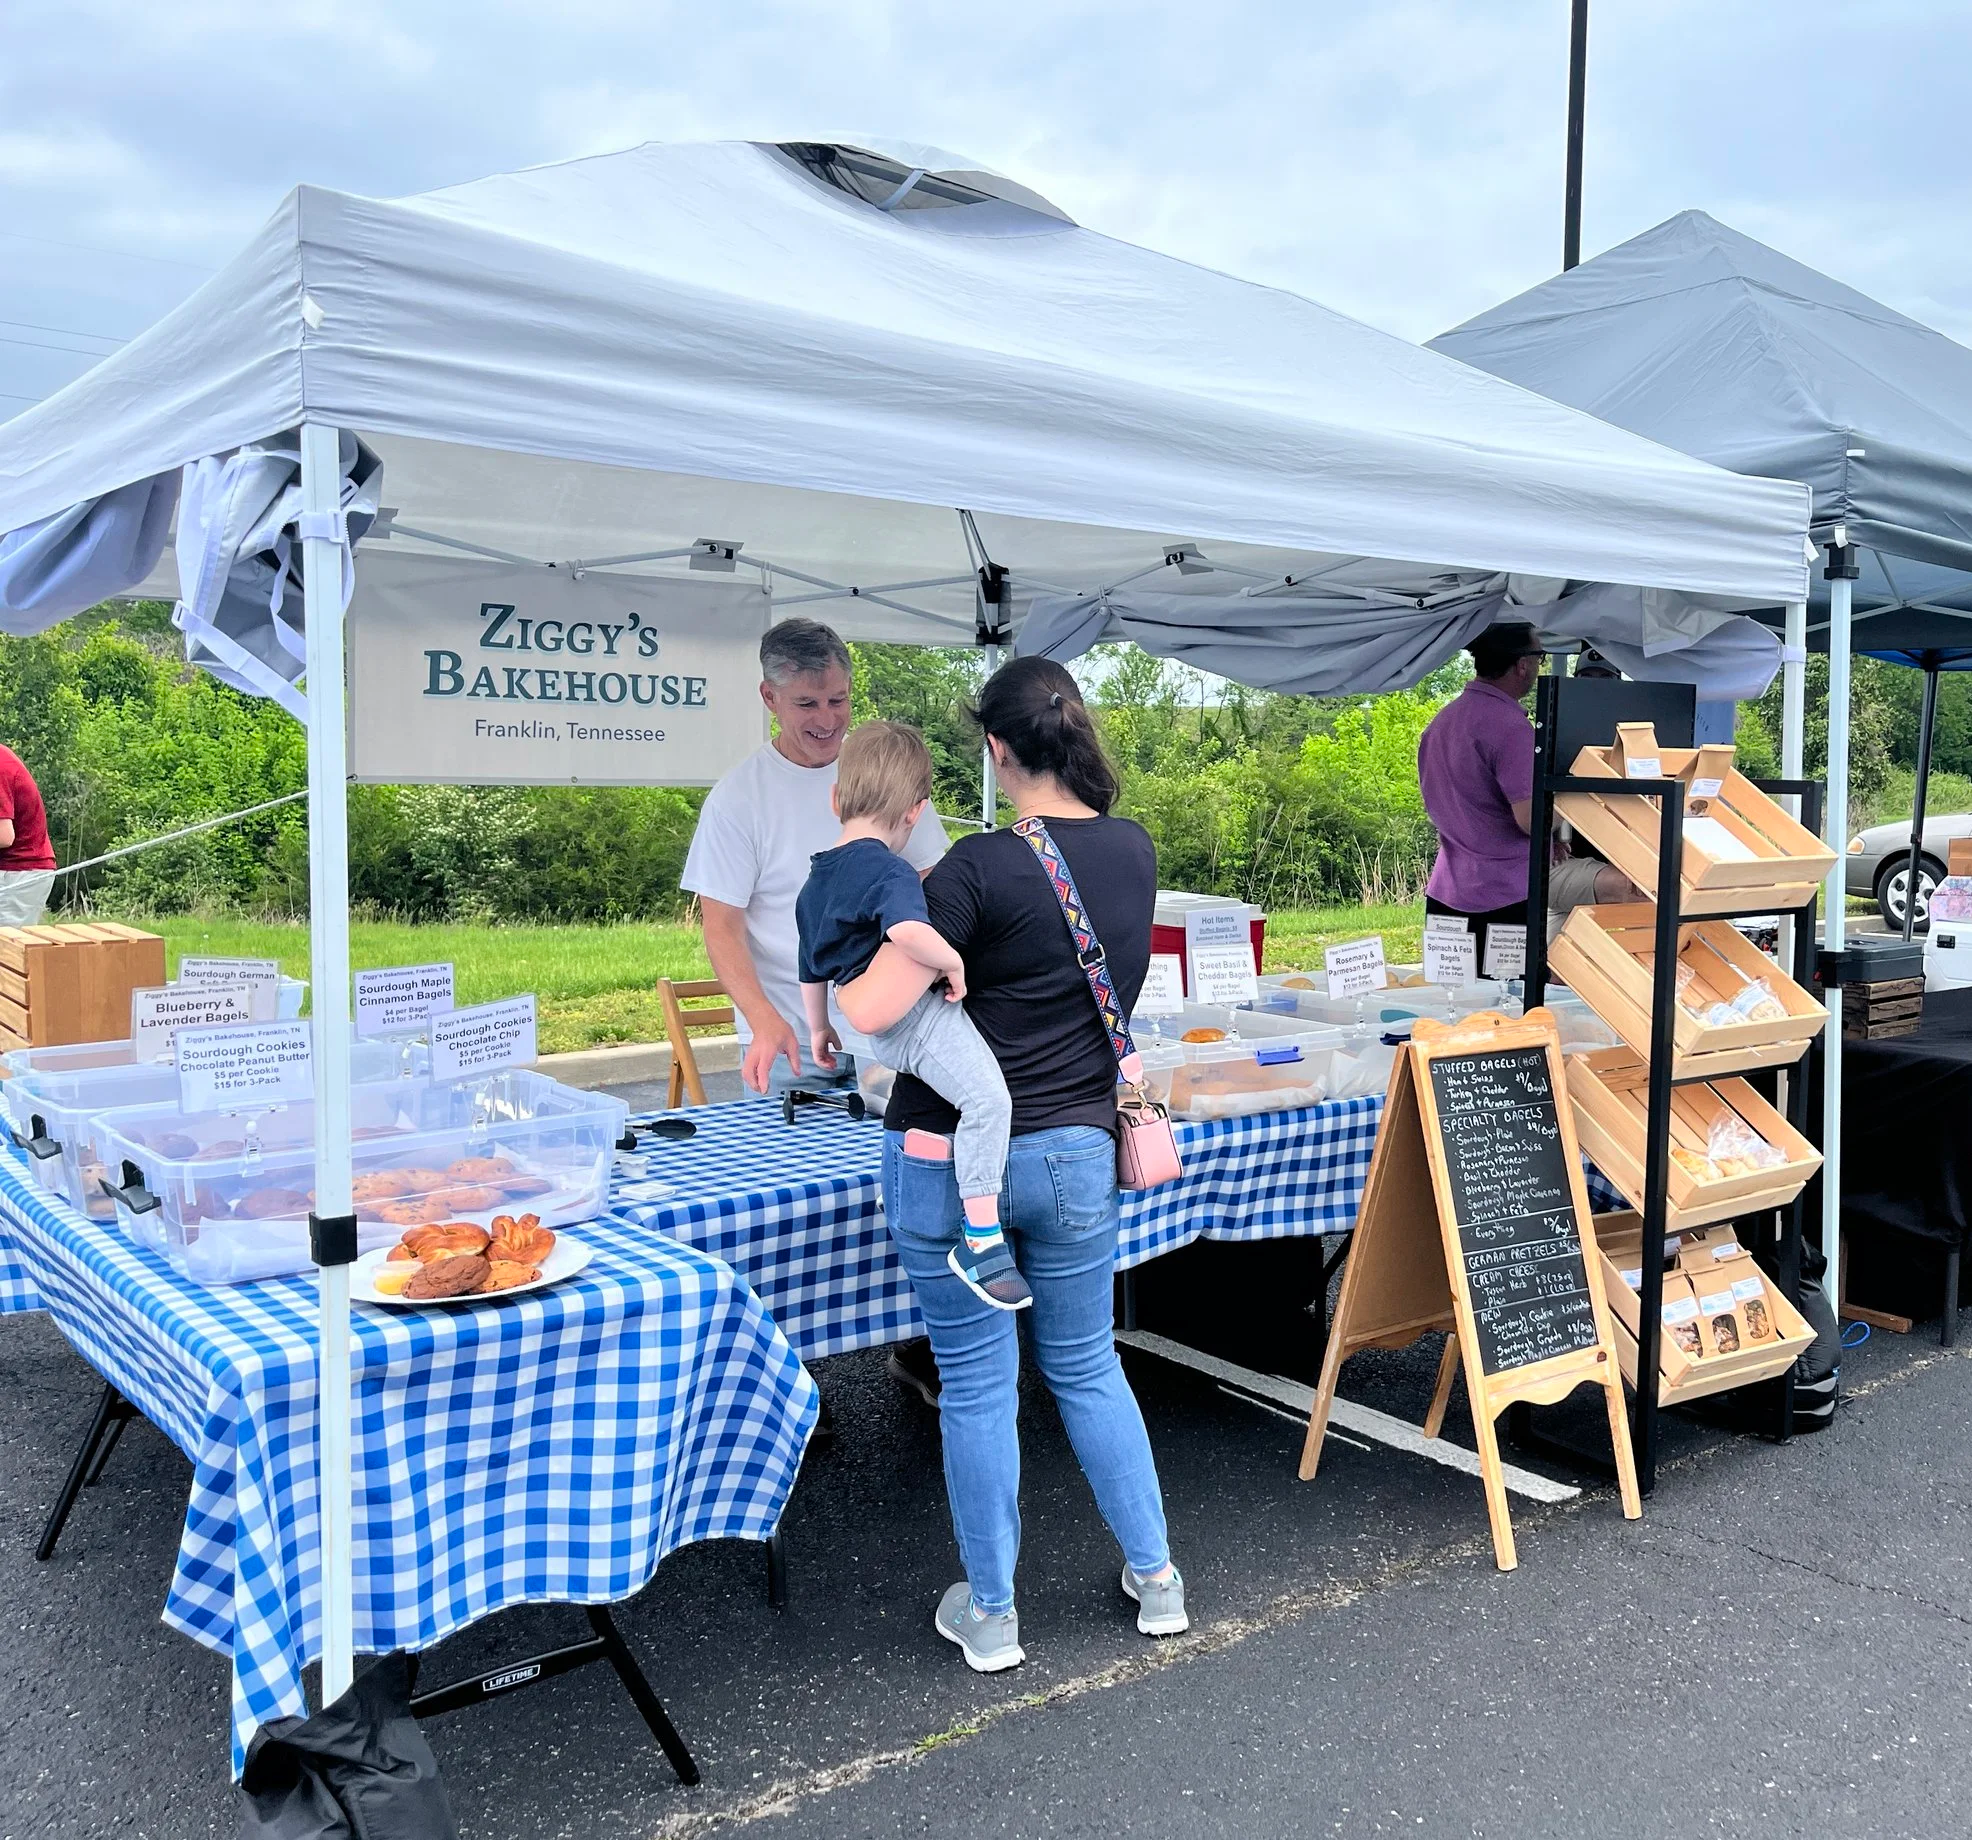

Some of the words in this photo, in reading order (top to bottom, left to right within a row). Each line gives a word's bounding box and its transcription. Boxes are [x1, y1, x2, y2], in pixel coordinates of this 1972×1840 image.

[422, 649, 708, 707] BAKEHOUSE
[475, 719, 561, 742] Franklin,
[566, 721, 666, 743] Tennessee
[1201, 916, 1214, 925] Hot
[1215, 915, 1235, 924] Items
[1427, 943, 1452, 952] Spinach
[1453, 945, 1458, 953] &
[1459, 945, 1473, 954] Feta
[1199, 961, 1221, 970] Sweet
[1222, 960, 1241, 969] Basil
[1242, 960, 1248, 968] &
[1336, 953, 1368, 966] Rosemary
[1440, 953, 1460, 963] Bagels
[183, 969, 237, 980] Sourdough
[239, 971, 275, 980] German
[1150, 962, 1168, 972] thing
[1198, 971, 1227, 981] Cheddar
[1229, 970, 1252, 980] Bagels
[1328, 965, 1361, 977] Parmesan
[1362, 959, 1384, 970] Bagels
[359, 980, 418, 994] Sourdough
[421, 976, 451, 988] Maple
[1146, 973, 1162, 982] gels
[144, 991, 168, 999] Ziggy's
[359, 994, 414, 1007] Cinnamon
[417, 988, 452, 1001] Bagels
[156, 1000, 221, 1013] Blueberry
[225, 998, 235, 1008] &
[385, 1008, 394, 1016] $4
[395, 1008, 407, 1016] per
[408, 1004, 429, 1013] Bagel
[140, 1014, 202, 1028] Lavender
[205, 1010, 249, 1023] Bagels
[382, 1016, 395, 1024] $12
[408, 1012, 430, 1021] 3-Pac
[185, 1034, 212, 1044] Ziggy's
[258, 1028, 289, 1037] Franklin,
[435, 1024, 491, 1043] Sourdough
[493, 1015, 533, 1030] Cookies
[448, 1034, 497, 1051] Chocolate
[499, 1029, 521, 1040] Chip
[182, 1044, 253, 1060] Sourdough
[256, 1040, 306, 1053] Cookies
[458, 1057, 473, 1067] $15
[474, 1055, 485, 1064] for
[486, 1049, 512, 1061] 3-Pack
[459, 1050, 469, 1058] $5
[470, 1048, 483, 1057] per
[484, 1041, 511, 1053] Cookie
[180, 1059, 236, 1072] Chocolate
[238, 1055, 276, 1066] Peanut
[278, 1052, 311, 1062] Butter
[1431, 1061, 1475, 1075] STUFFED
[1480, 1058, 1516, 1072] BAGELS
[214, 1070, 226, 1080] $5
[228, 1070, 244, 1080] per
[246, 1066, 280, 1076] Cookie
[214, 1080, 232, 1090] $15
[233, 1079, 248, 1088] for
[249, 1076, 282, 1087] 3-Pack
[1442, 1112, 1497, 1133] SPECIALTY
[1503, 1106, 1543, 1123] BAGELS
[1509, 1202, 1529, 1216] Feta
[1468, 1251, 1506, 1270] GERMAN
[1510, 1243, 1557, 1260] PRETZELS
[1472, 1270, 1503, 1288] CREAM
[1509, 1263, 1540, 1278] CHEESE
[1480, 1307, 1502, 1325] NEW
[489, 1668, 534, 1688] LIFETIME
